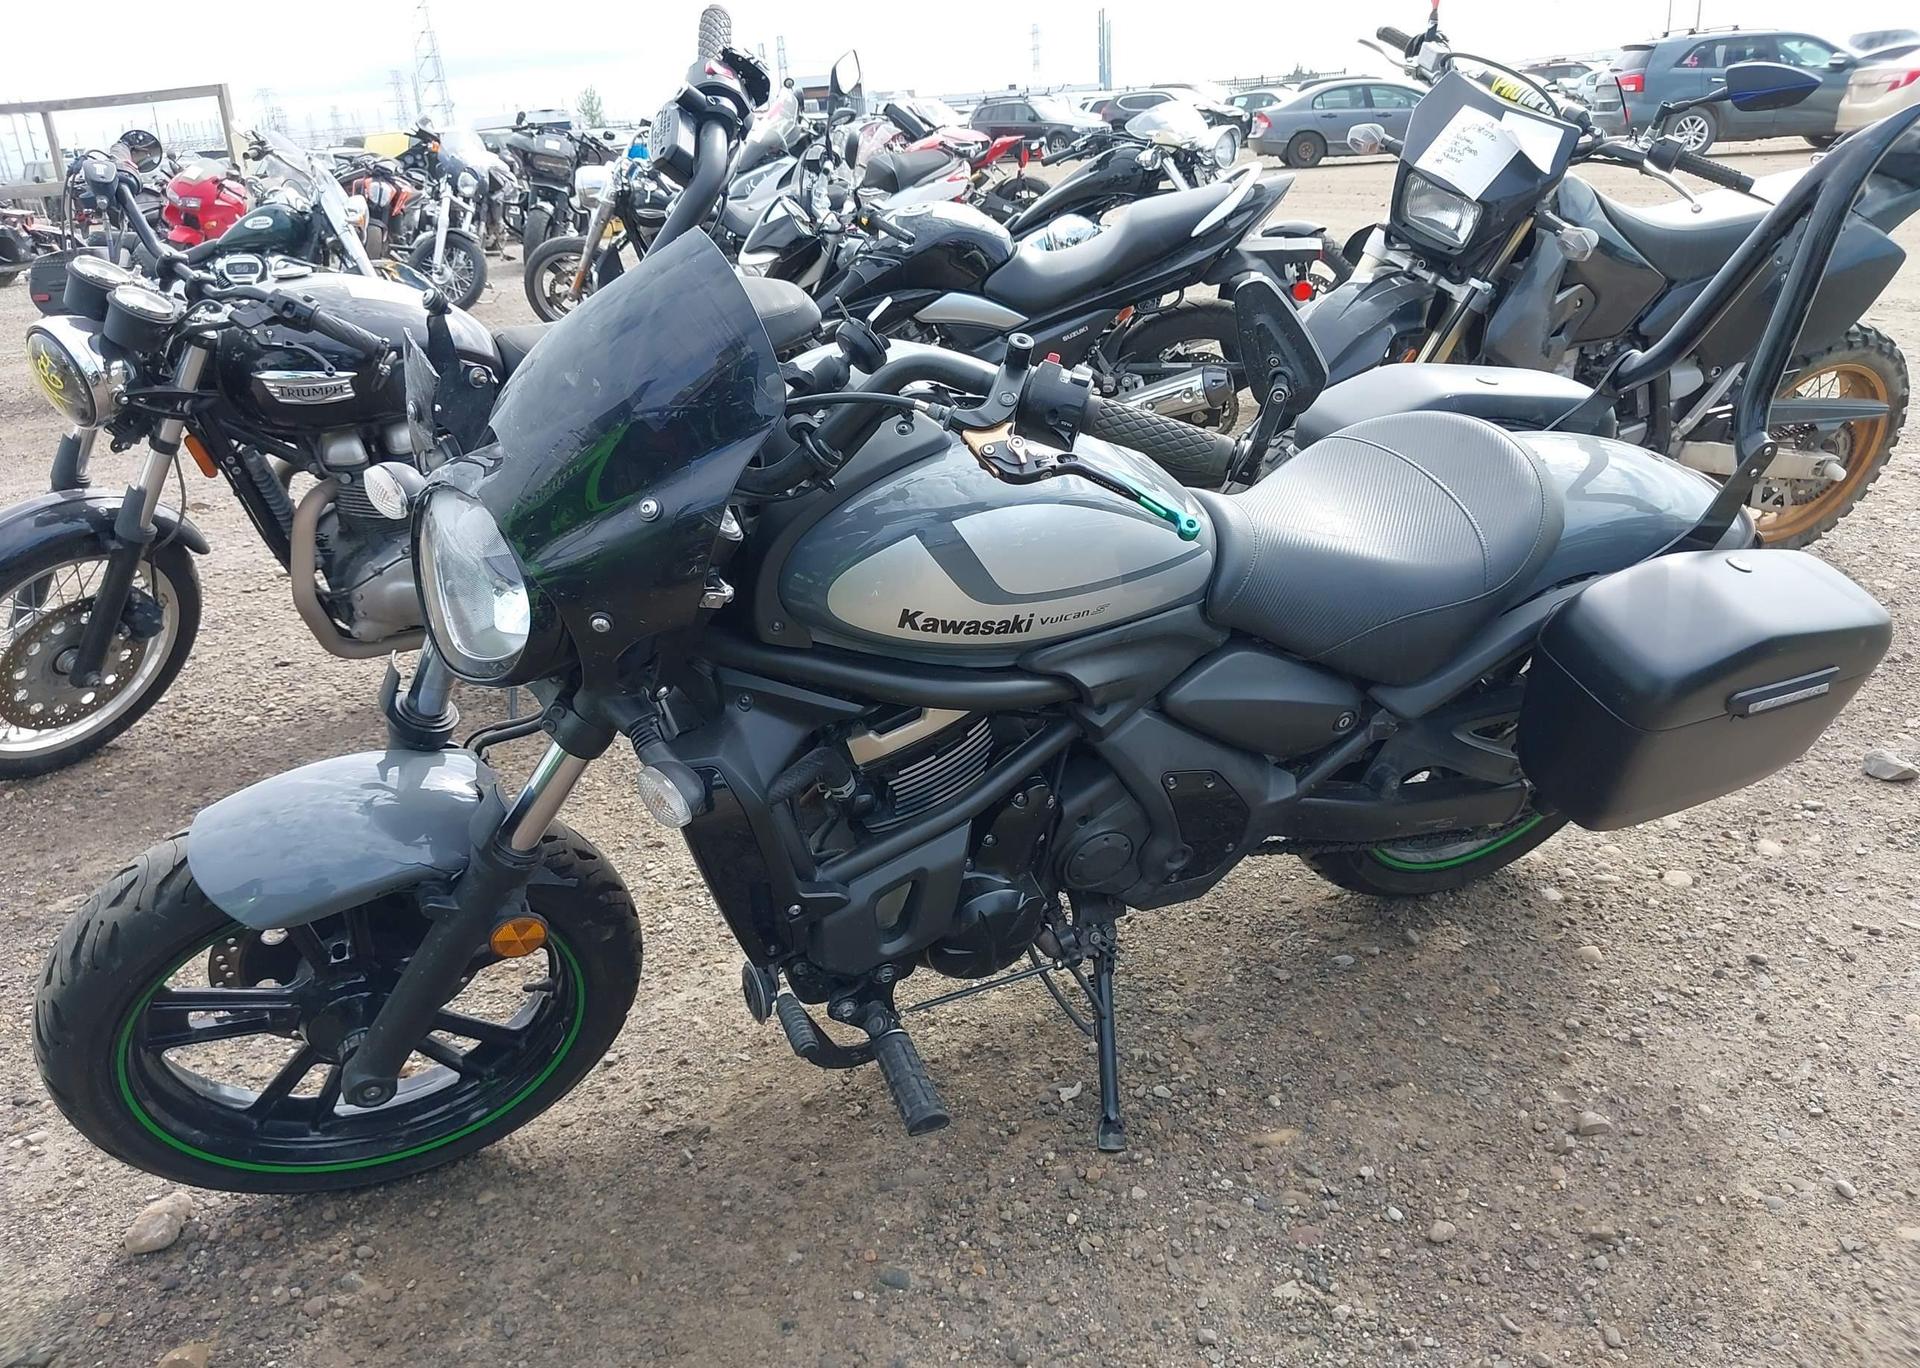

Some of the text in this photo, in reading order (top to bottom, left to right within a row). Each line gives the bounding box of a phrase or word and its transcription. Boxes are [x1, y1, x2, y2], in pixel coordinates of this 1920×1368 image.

[1493, 75, 1553, 116] PROTAPE
[1062, 325, 1089, 342] SUZUKI
[279, 384, 344, 398] TRIUMPH
[897, 608, 1035, 636] Kawasaki
